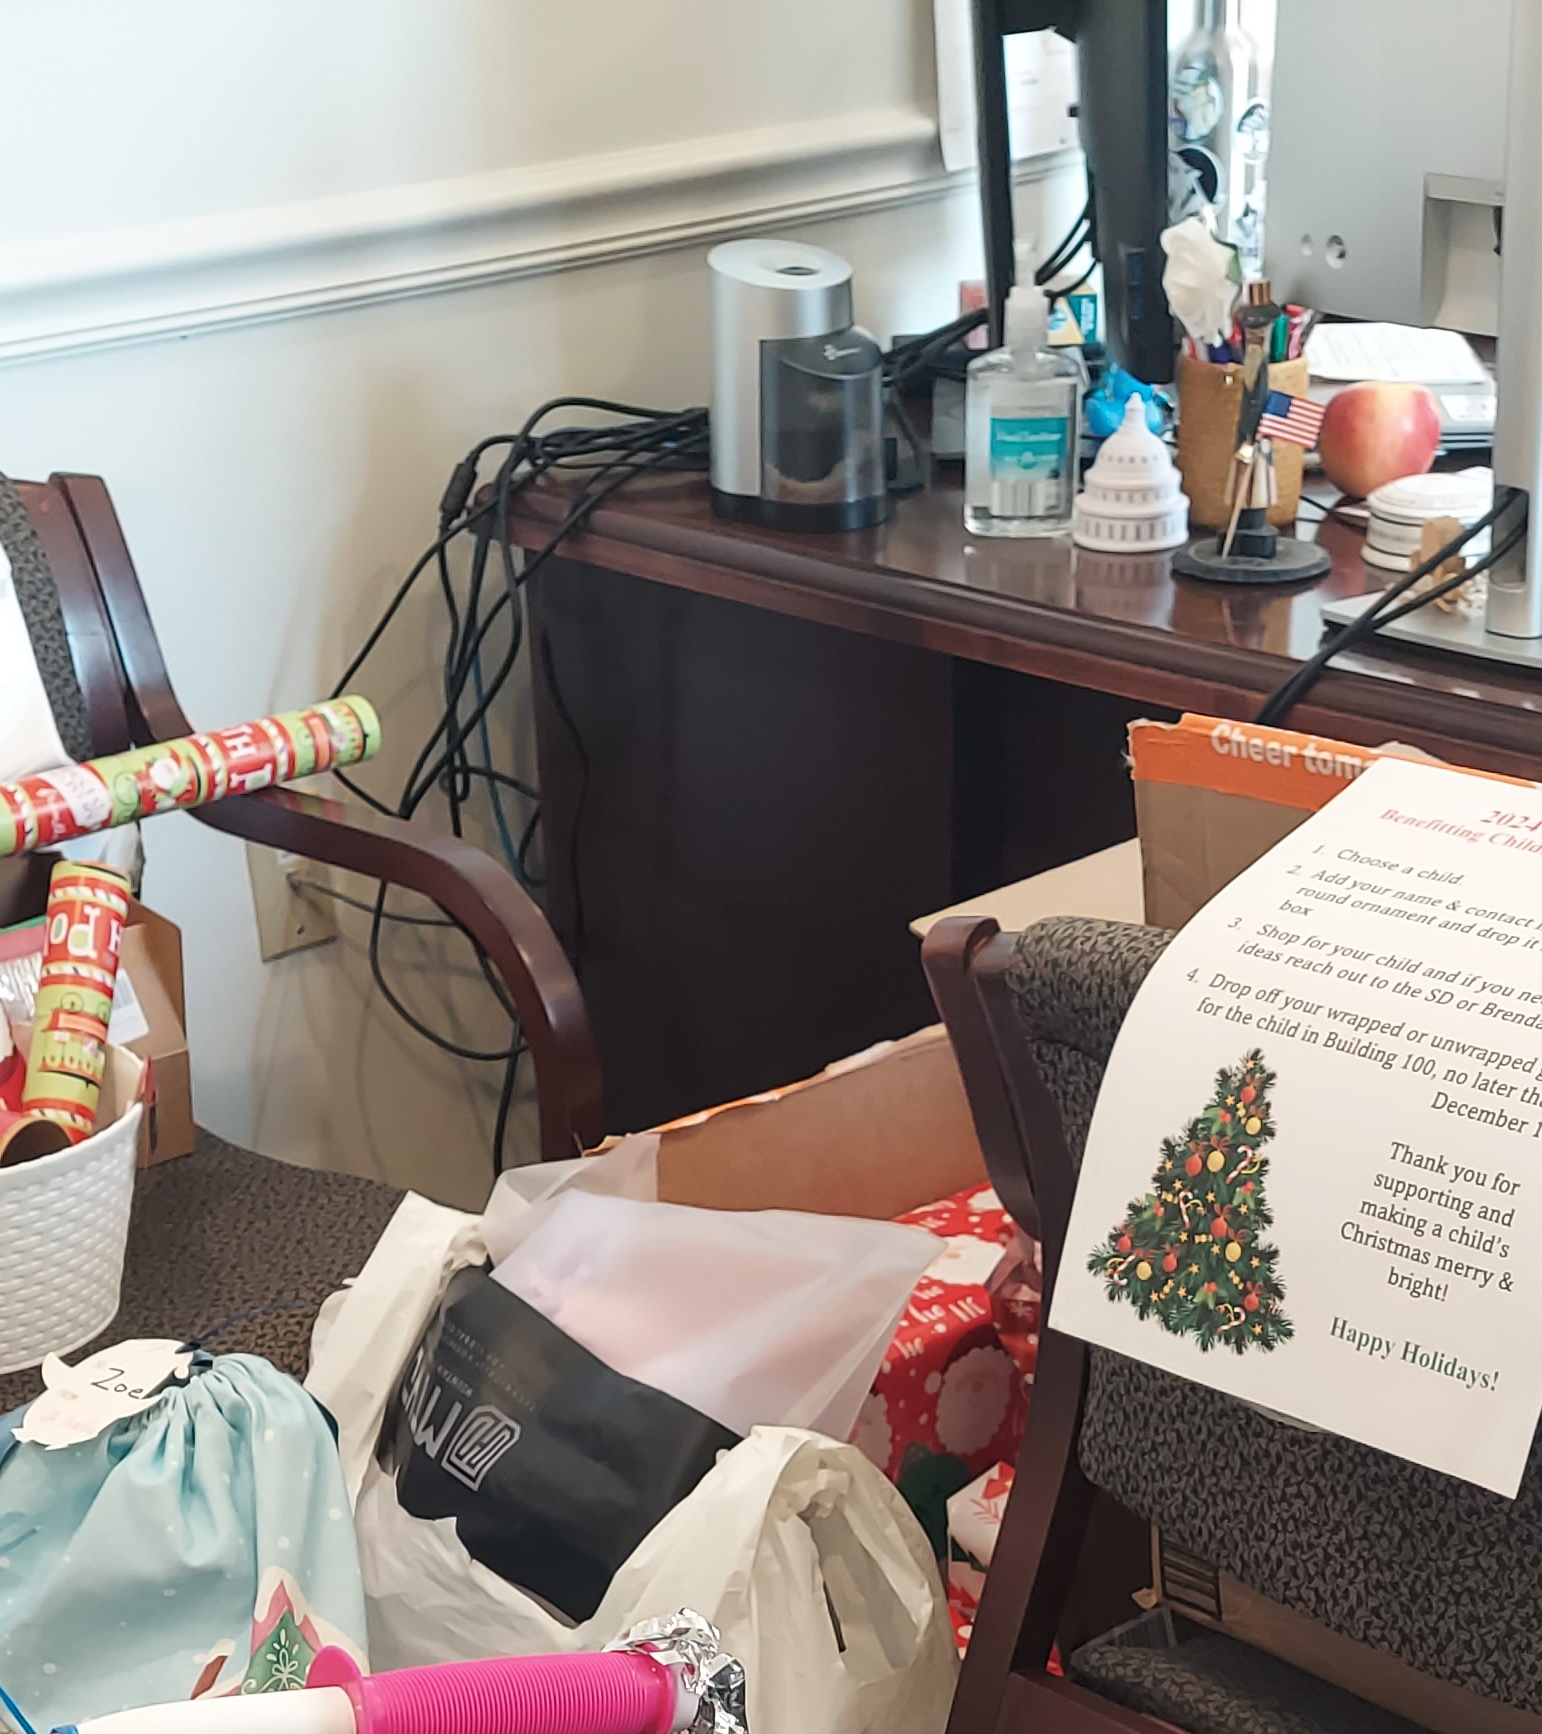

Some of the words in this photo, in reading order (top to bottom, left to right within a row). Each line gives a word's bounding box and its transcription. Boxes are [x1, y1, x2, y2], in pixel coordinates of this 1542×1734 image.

[1211, 724, 1296, 767] Cheer
[1379, 808, 1487, 843] Benefitting
[1336, 848, 1400, 872] Choose
[1401, 865, 1414, 875] a
[1279, 899, 1314, 917] box
[1295, 885, 1352, 906] round
[1350, 899, 1438, 926] ornament
[1437, 918, 1477, 935] and
[1476, 925, 1521, 947] drop
[1522, 936, 1539, 950] it
[1311, 869, 1350, 887] Add
[1349, 877, 1392, 897] your
[1391, 889, 1443, 908] name
[1445, 899, 1462, 912] &
[1464, 904, 1535, 930] contact
[1236, 940, 1284, 963] ideas
[1284, 955, 1334, 976] reach
[1337, 968, 1368, 985] out
[1369, 976, 1390, 990] to
[1391, 981, 1423, 999] the
[1423, 987, 1455, 1006] SD
[1456, 998, 1482, 1012] or
[1256, 923, 1301, 946] Shop
[1301, 935, 1331, 950] for
[1330, 943, 1375, 963] your
[1375, 952, 1423, 975] child
[1421, 966, 1461, 984] and
[1460, 973, 1482, 988] if
[1473, 979, 1515, 998] you
[1196, 996, 1224, 1017] for
[1225, 1005, 1254, 1027] the
[1256, 1014, 1302, 1039] child
[1300, 1024, 1320, 1045] in
[1322, 1031, 1398, 1070] Building
[1401, 1052, 1437, 1081] 100,
[1442, 1067, 1469, 1086] no
[1470, 1071, 1518, 1099] later
[1208, 973, 1252, 998] Drop
[1255, 987, 1285, 1005] off
[1278, 998, 1323, 1017] your
[1326, 1006, 1406, 1038] wrapped
[1405, 1026, 1429, 1043] or
[1430, 1034, 1539, 1074] unwrapped
[1430, 1091, 1530, 1134] December
[1390, 1141, 1450, 1176] Thank
[1449, 1164, 1488, 1188] you
[1490, 1171, 1522, 1197] for
[1359, 1199, 1428, 1239] making
[1431, 1223, 1444, 1239] a
[1447, 1225, 1511, 1260] child's
[1373, 1172, 1475, 1220] supporting
[1477, 1204, 1516, 1229] and
[1340, 1220, 1432, 1266] Christmas
[1434, 1254, 1495, 1290] merry
[1497, 1271, 1515, 1293] &
[1386, 1265, 1450, 1303] bright!
[91, 1367, 144, 1400] Zoe
[1330, 1316, 1396, 1361] Happy
[1399, 1340, 1500, 1393] Holidays!
